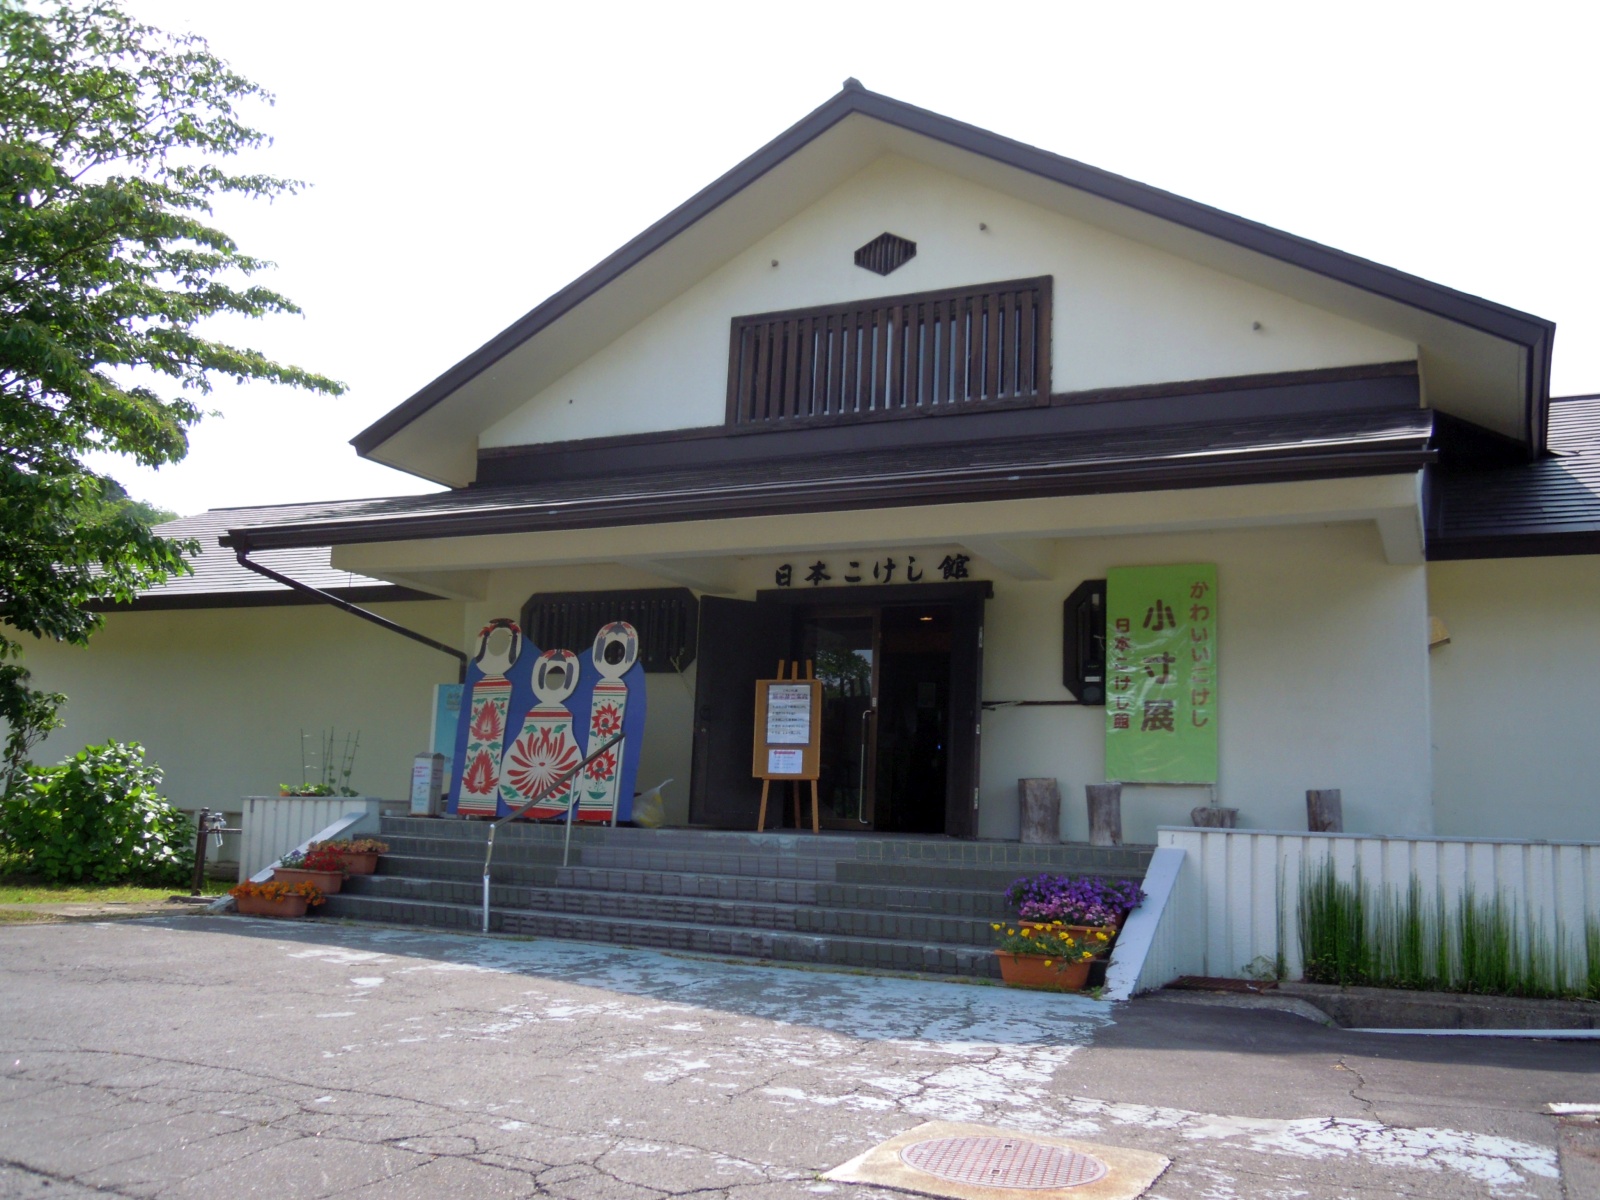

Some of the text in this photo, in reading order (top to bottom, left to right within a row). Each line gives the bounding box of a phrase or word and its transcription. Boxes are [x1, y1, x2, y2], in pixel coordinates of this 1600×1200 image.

[775, 553, 971, 588] 日本こけし館
[1113, 618, 1131, 729] 日本こけし館
[1140, 599, 1177, 732] 小寸展
[1189, 581, 1210, 728] かわいいこけし
